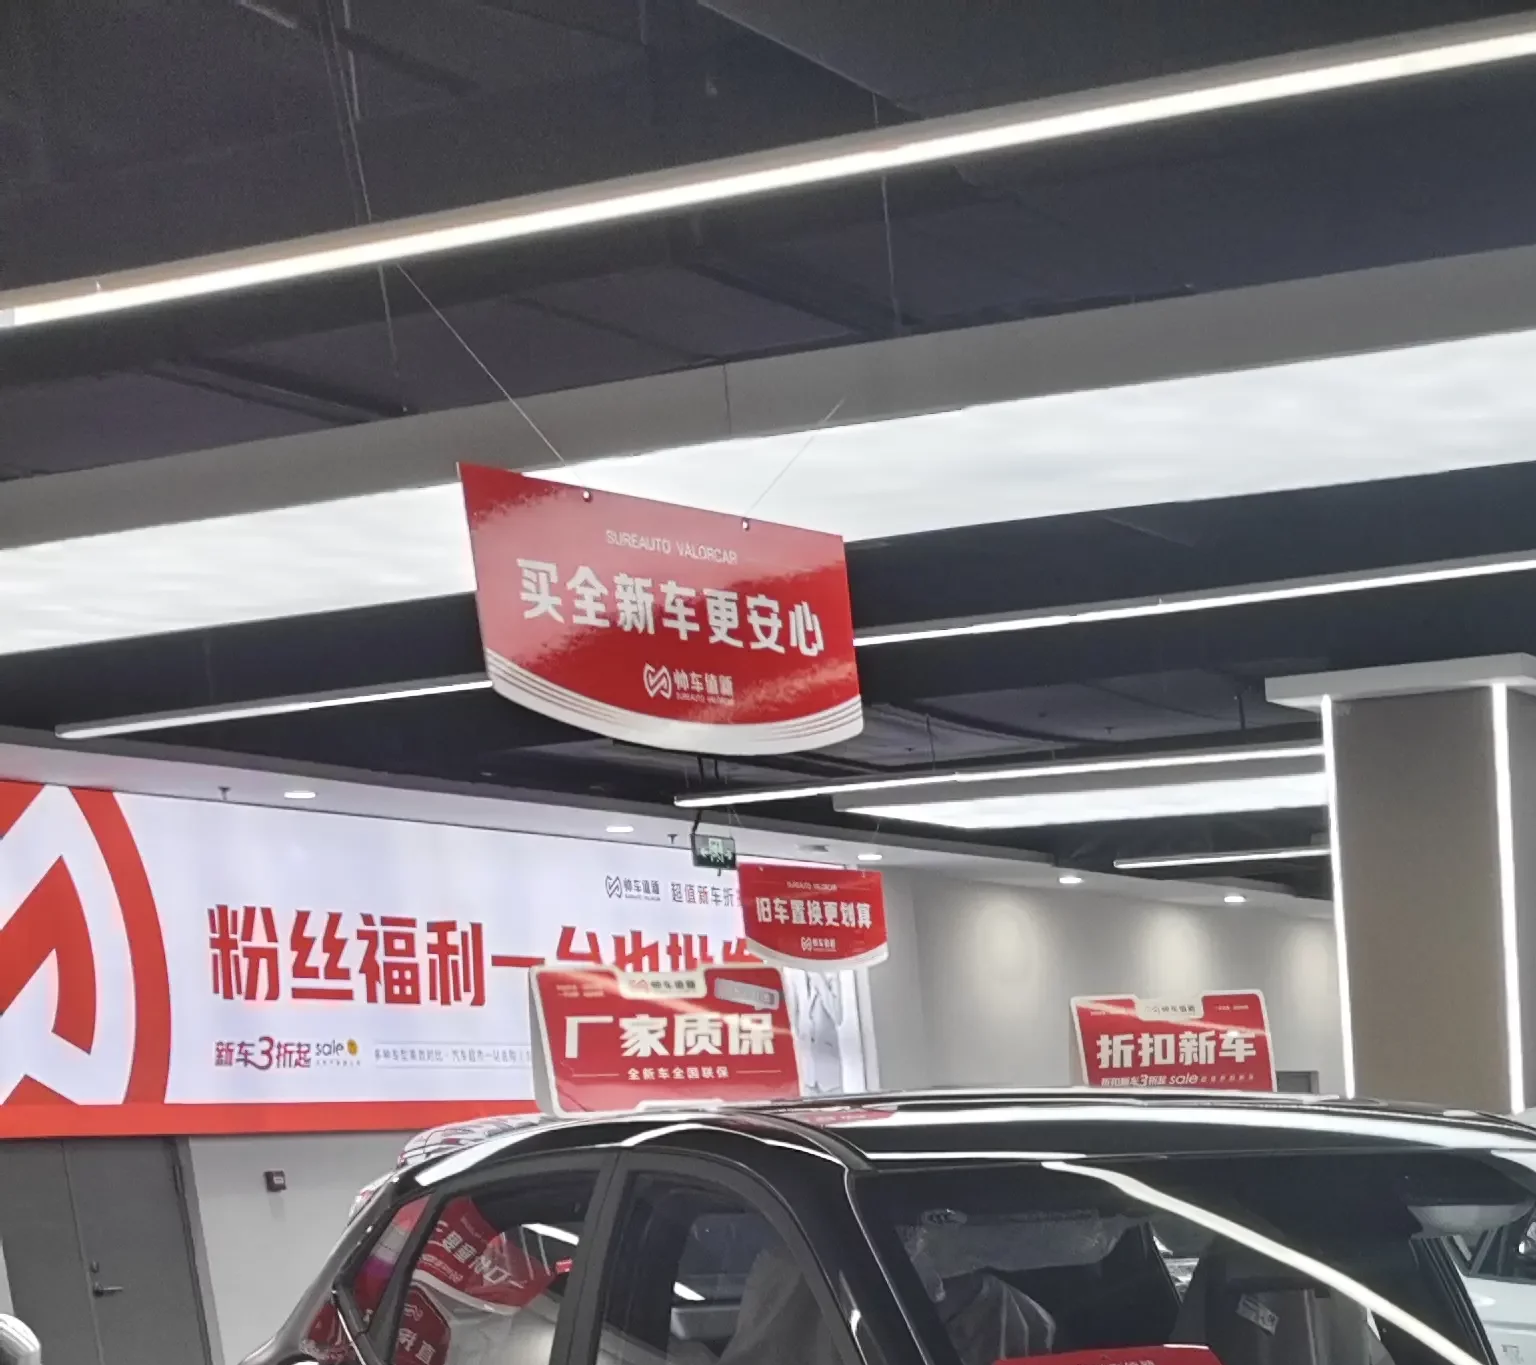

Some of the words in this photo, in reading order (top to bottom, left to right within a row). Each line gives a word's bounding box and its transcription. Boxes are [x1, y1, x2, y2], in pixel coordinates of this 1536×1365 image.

[516, 557, 825, 657] 买全新车更安心
[671, 881, 742, 907] 超值新车折
[755, 896, 873, 930] 旧车置换更划算
[314, 1039, 345, 1057] sale
[563, 1013, 775, 1059] 厂家质保
[1095, 1029, 1257, 1069] 折扣新车
[1168, 1072, 1199, 1085] sale
